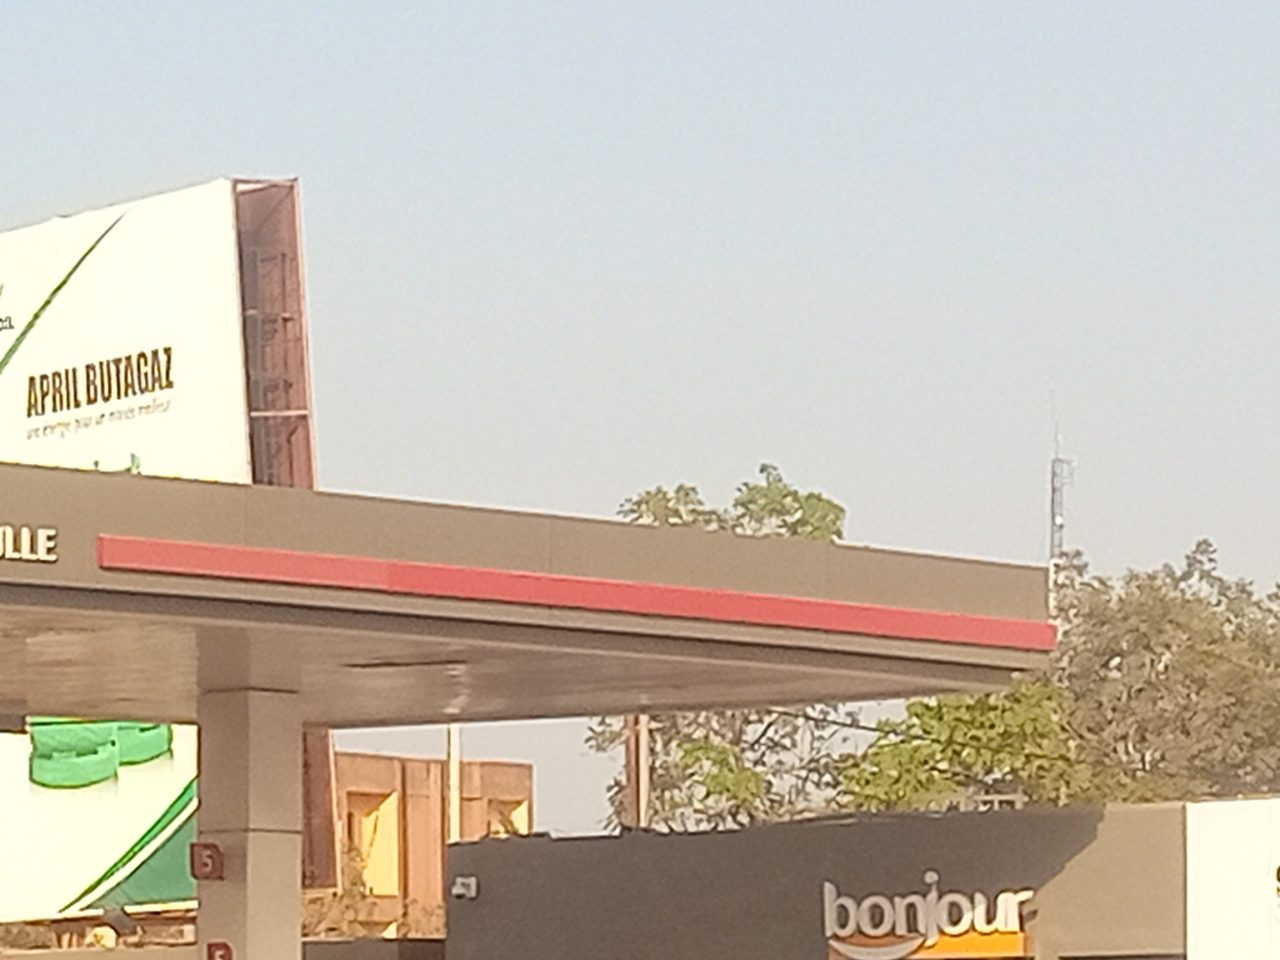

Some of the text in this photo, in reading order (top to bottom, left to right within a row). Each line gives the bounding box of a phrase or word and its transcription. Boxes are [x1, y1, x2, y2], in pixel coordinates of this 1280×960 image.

[26, 367, 82, 419] APRIL
[85, 346, 174, 405] BUTAGAZ
[201, 851, 213, 876] 5
[824, 870, 1035, 948] bonjour
